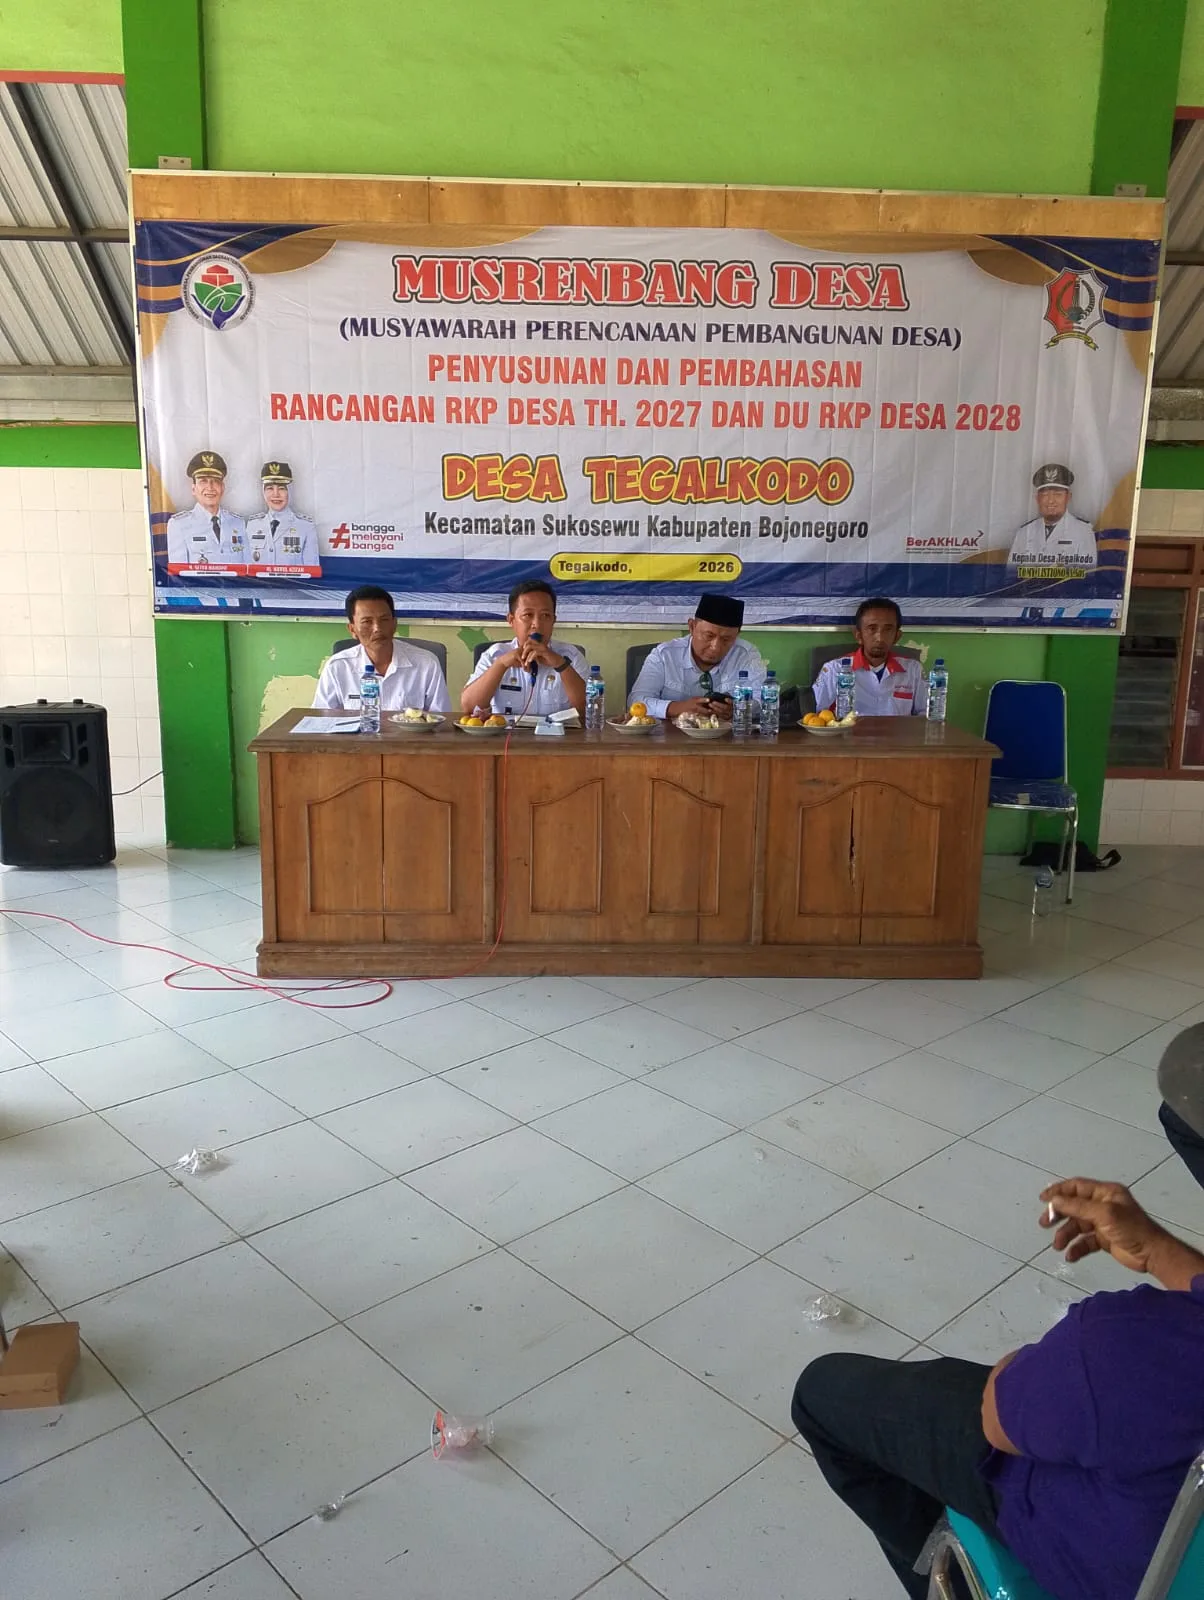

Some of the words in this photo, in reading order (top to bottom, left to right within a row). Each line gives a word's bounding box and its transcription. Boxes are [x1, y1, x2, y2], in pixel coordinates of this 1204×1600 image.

[392, 255, 760, 307] MUSRENBANG
[769, 261, 910, 311] DESA
[340, 318, 515, 341] (MUSYAWARAH
[527, 321, 696, 342] PERENCANAAN
[706, 323, 883, 345] PEMBANGUNAN
[893, 327, 961, 350] DESA)
[429, 355, 606, 384] PENYUSUNAN
[617, 358, 669, 385] DAN
[680, 359, 862, 388] PEMBAHASAN
[271, 394, 434, 423] RANCANGAN
[446, 397, 497, 424] RKP
[508, 398, 575, 425] DESA
[584, 399, 625, 426] TH.
[636, 400, 701, 427] 2027
[712, 401, 763, 428] DAN
[774, 401, 809, 428] DU
[820, 402, 871, 428] RKP
[881, 403, 946, 429] DESA
[955, 404, 1020, 431] 2028
[442, 453, 568, 503] DESA
[582, 455, 854, 506] TEGALKODO
[352, 523, 395, 533] bangga
[352, 532, 403, 542] melayani
[425, 512, 535, 535] Kecamatan
[543, 514, 638, 537] Sukosewu
[648, 515, 751, 542] Kabupaten
[759, 516, 868, 543] Bojonegoro
[352, 541, 394, 552] bangsa
[907, 537, 979, 546] BerAKHLAK
[558, 560, 632, 574] Tegalkodo,
[699, 561, 735, 573] 2026
[1012, 552, 1036, 563] Kepala
[1039, 553, 1055, 562] Desa
[1058, 554, 1093, 564] Tegalkodo
